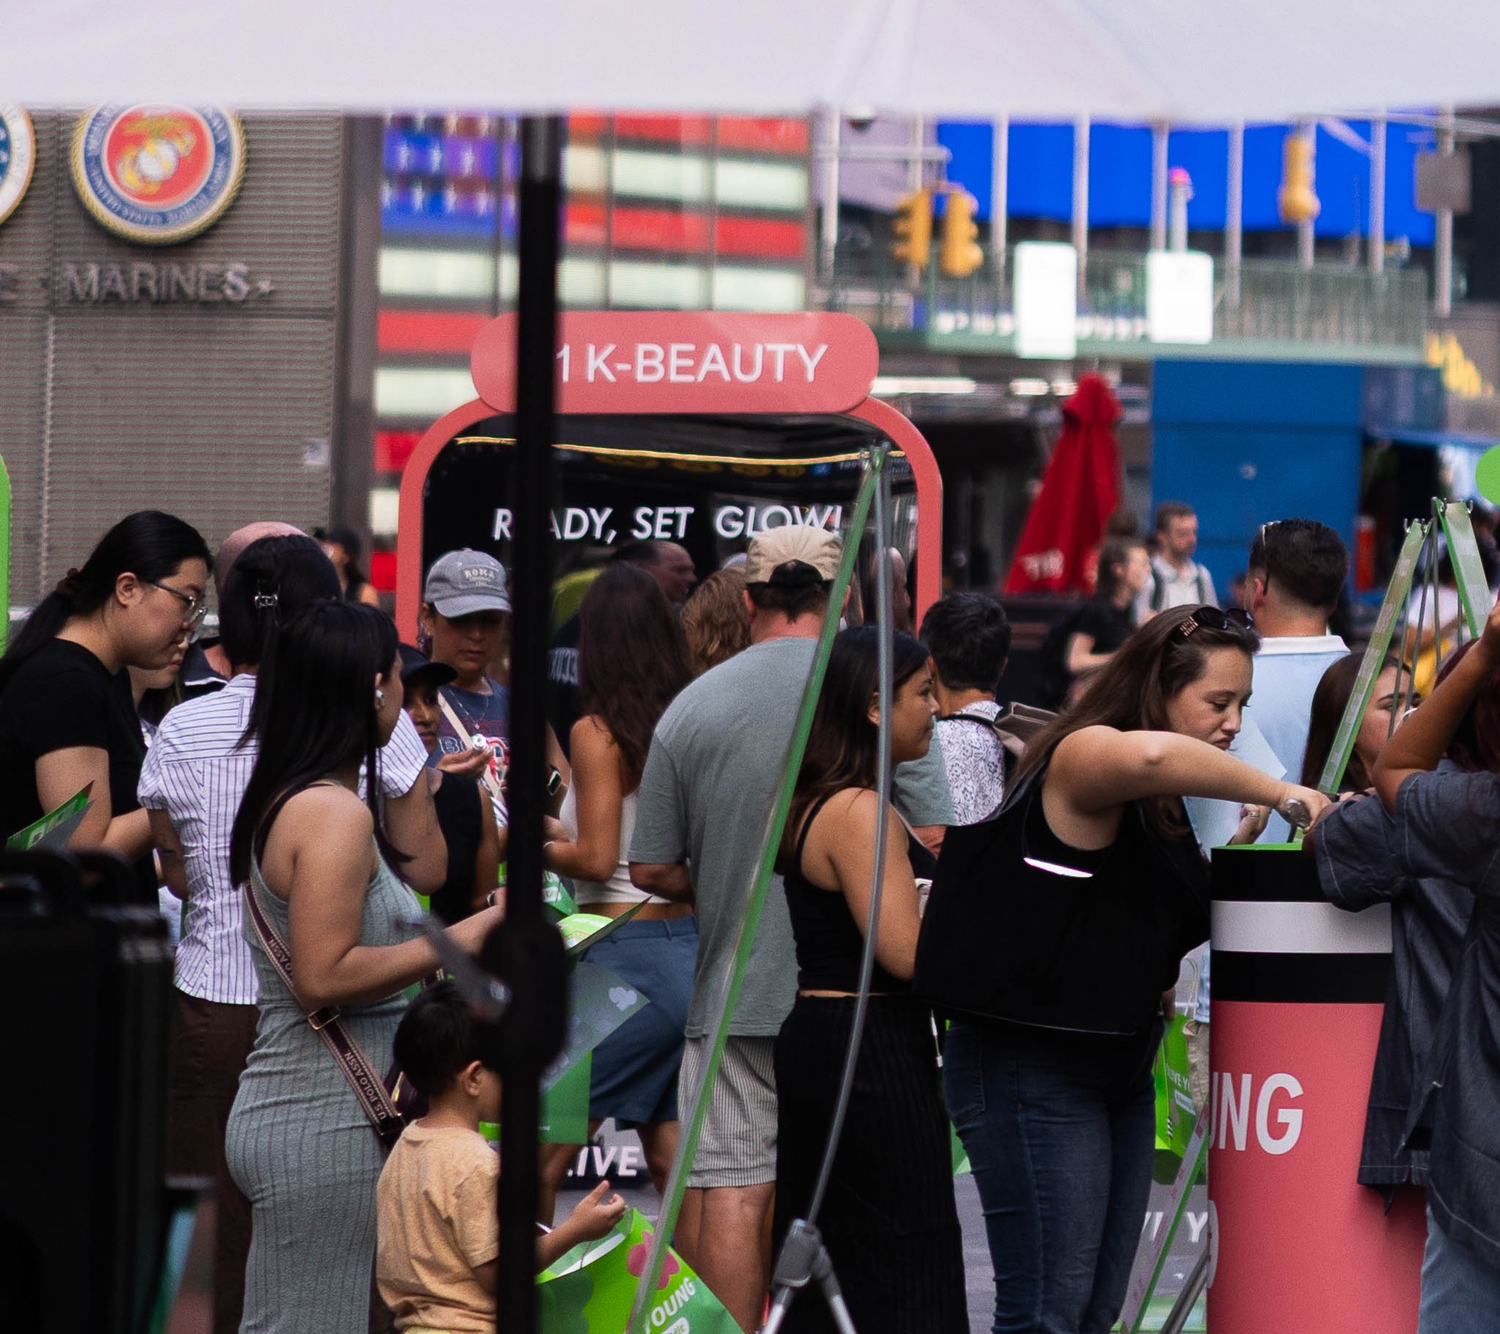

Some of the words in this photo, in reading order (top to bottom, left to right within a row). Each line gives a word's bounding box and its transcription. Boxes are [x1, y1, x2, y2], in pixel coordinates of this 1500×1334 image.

[66, 261, 250, 302] MARINES
[586, 342, 829, 384] K-BEAUTY
[492, 505, 617, 545] RDY,
[630, 505, 695, 541] SET
[343, 1050, 366, 1078] ASSN
[359, 1077, 380, 1104] POLO
[567, 1144, 640, 1178] IVE
